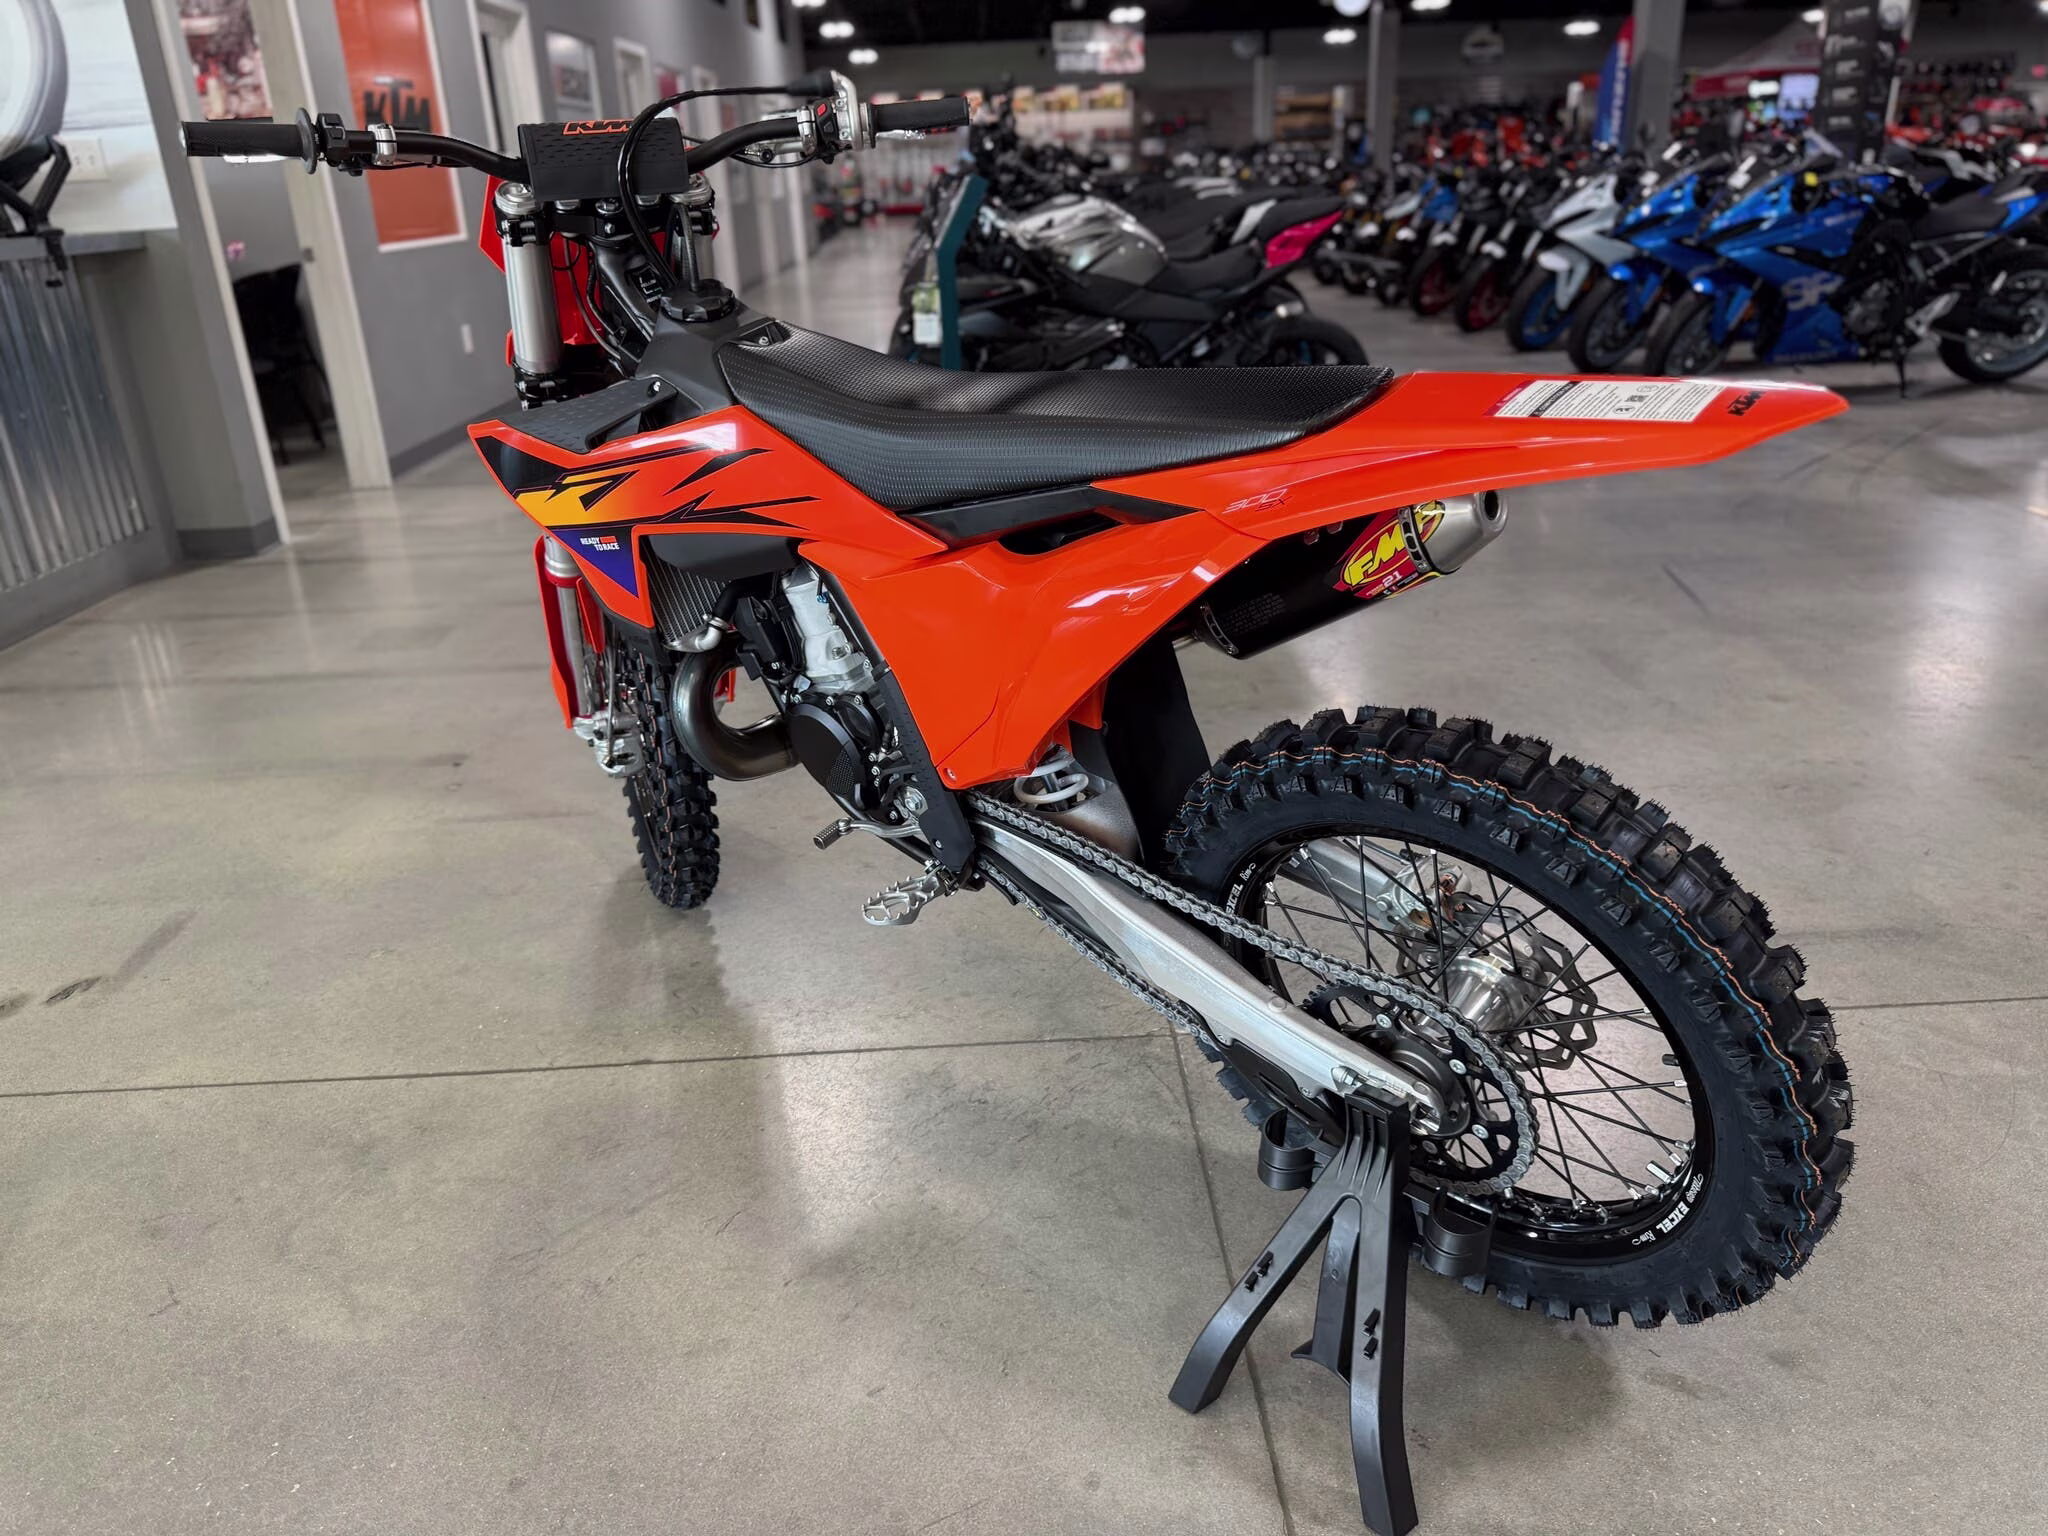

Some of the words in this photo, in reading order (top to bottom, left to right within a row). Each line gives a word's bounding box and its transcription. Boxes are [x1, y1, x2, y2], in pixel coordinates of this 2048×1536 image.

[363, 77, 431, 133] KTM
[1727, 390, 1766, 416] KTM
[579, 537, 600, 545] READY
[603, 542, 620, 551] RACE
[1225, 883, 1244, 915] EXCEL
[1655, 1200, 1691, 1234] EXCEL
